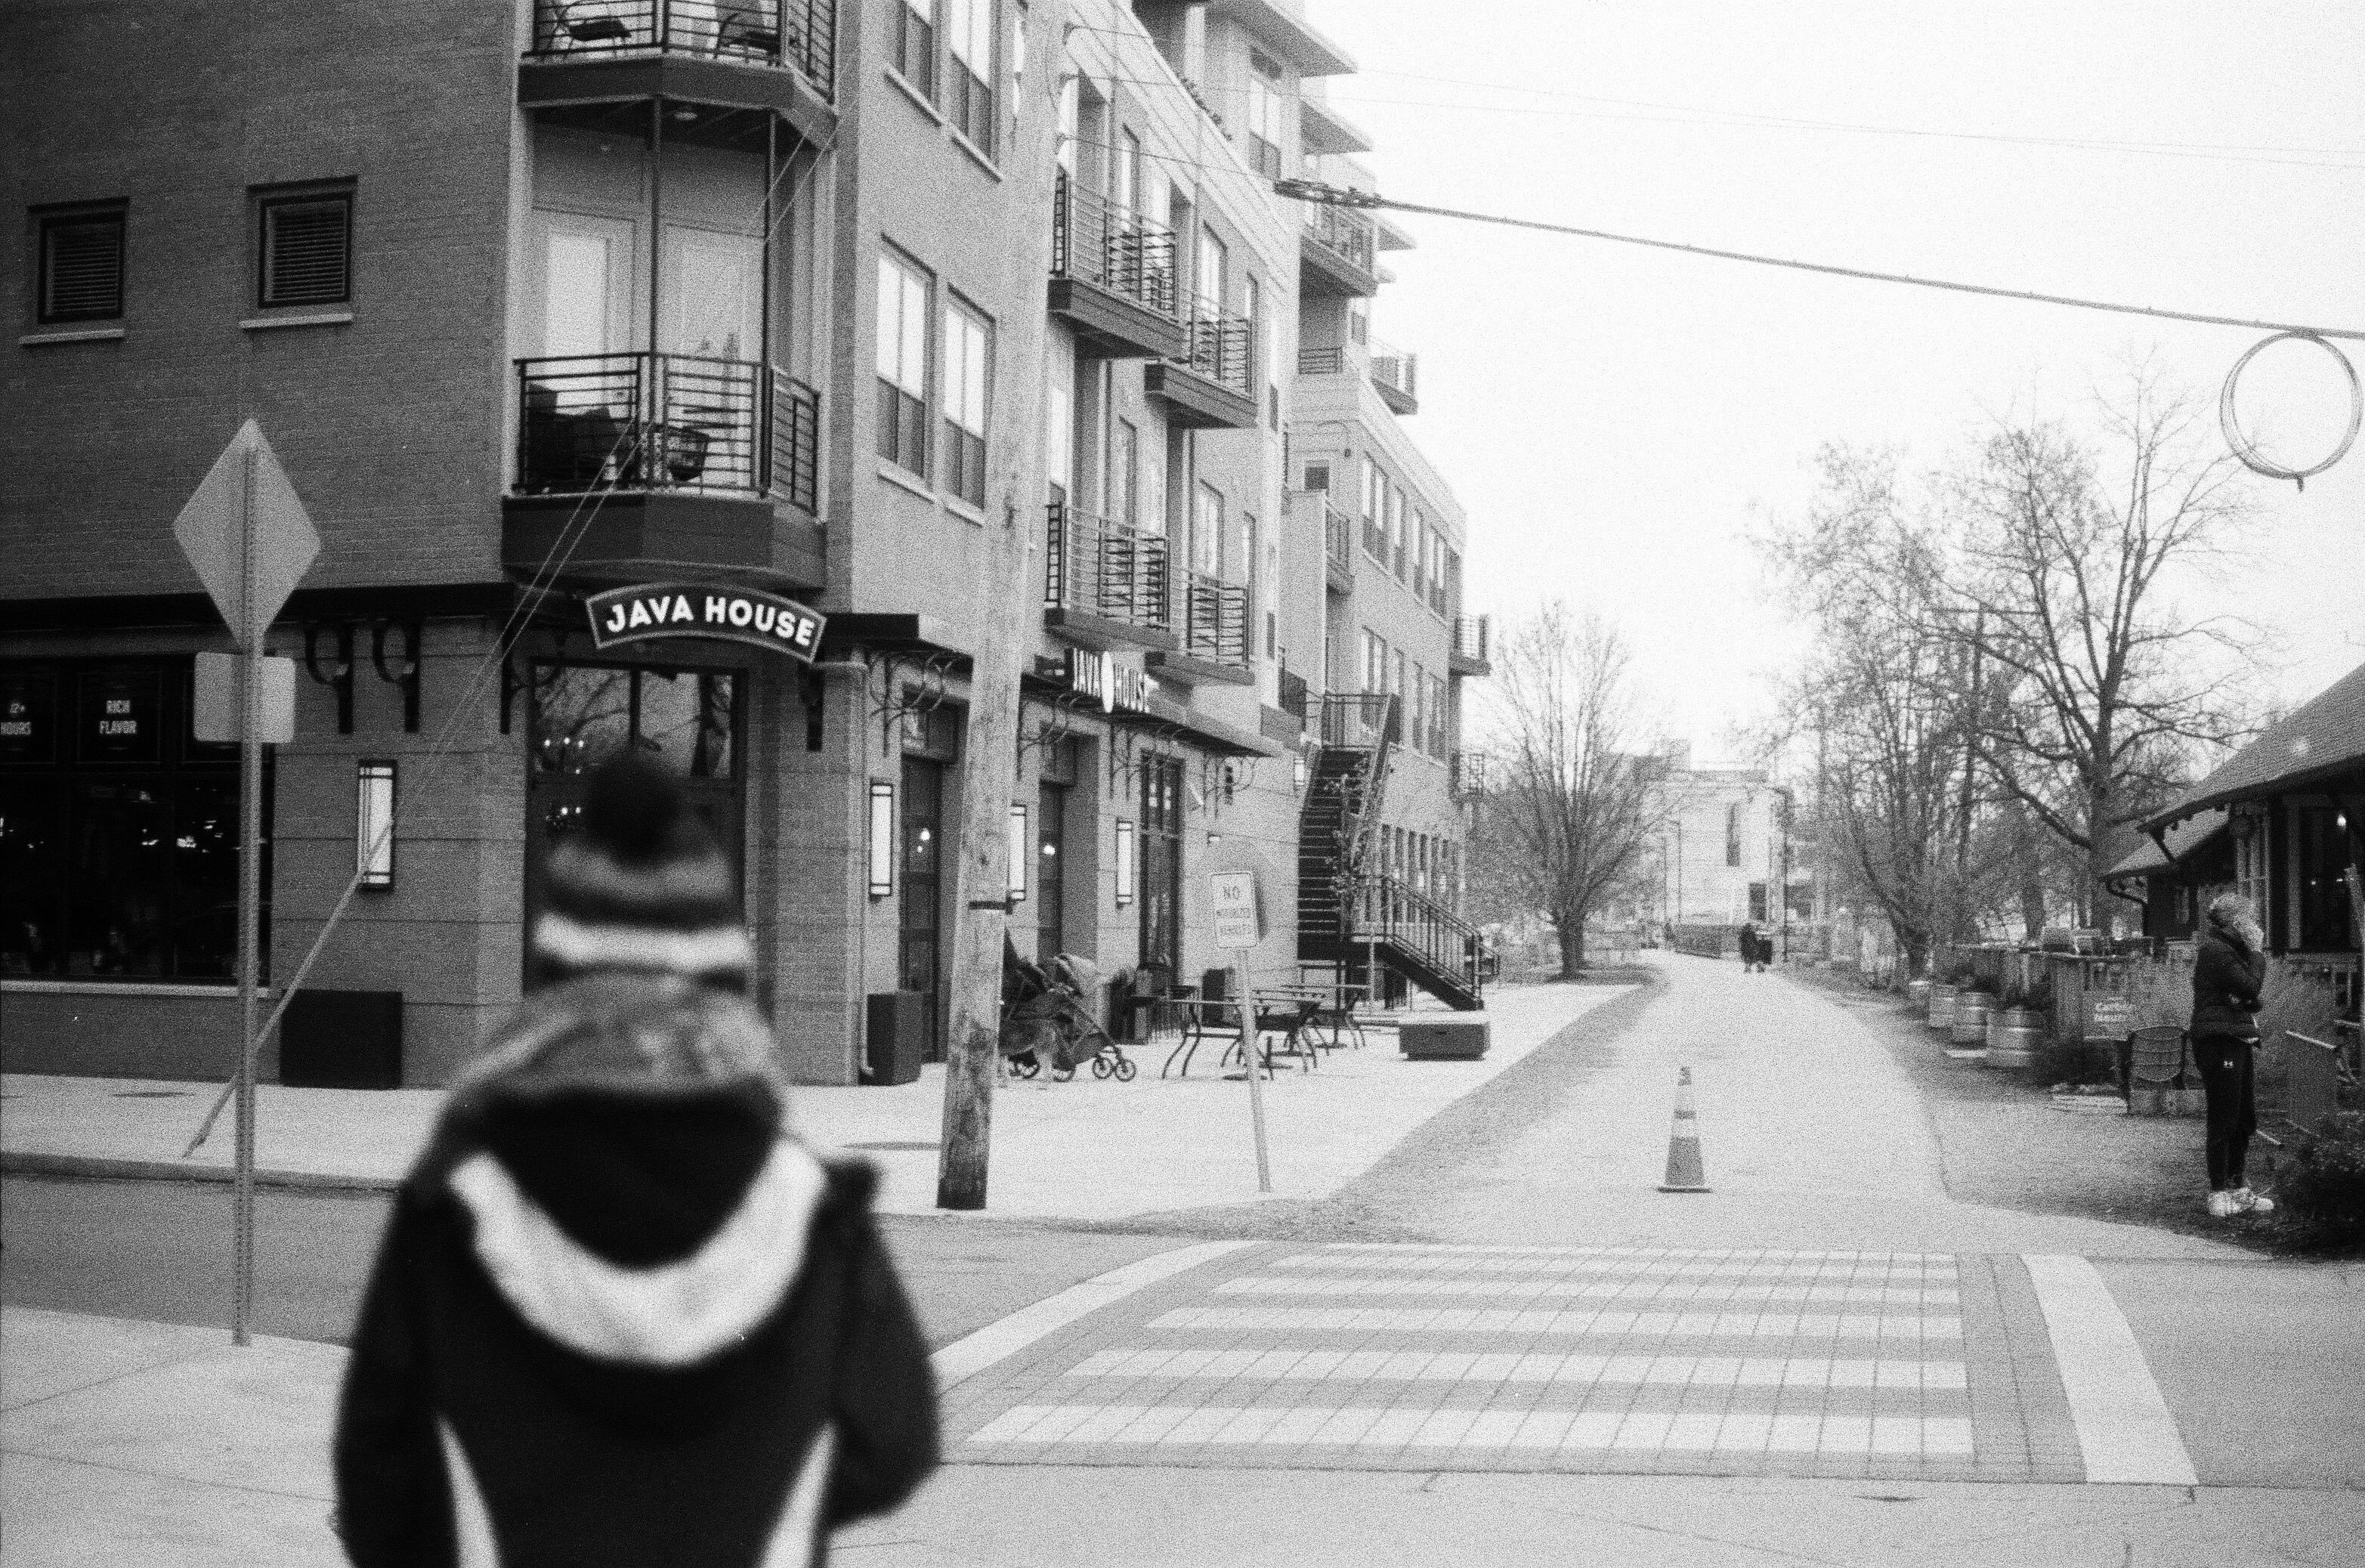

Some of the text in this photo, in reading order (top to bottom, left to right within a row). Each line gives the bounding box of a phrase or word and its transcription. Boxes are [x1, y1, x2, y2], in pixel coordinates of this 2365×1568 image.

[607, 595, 815, 647] JAVA HOUSE
[99, 720, 138, 735] FLAVOR
[1223, 886, 1240, 900] NO
